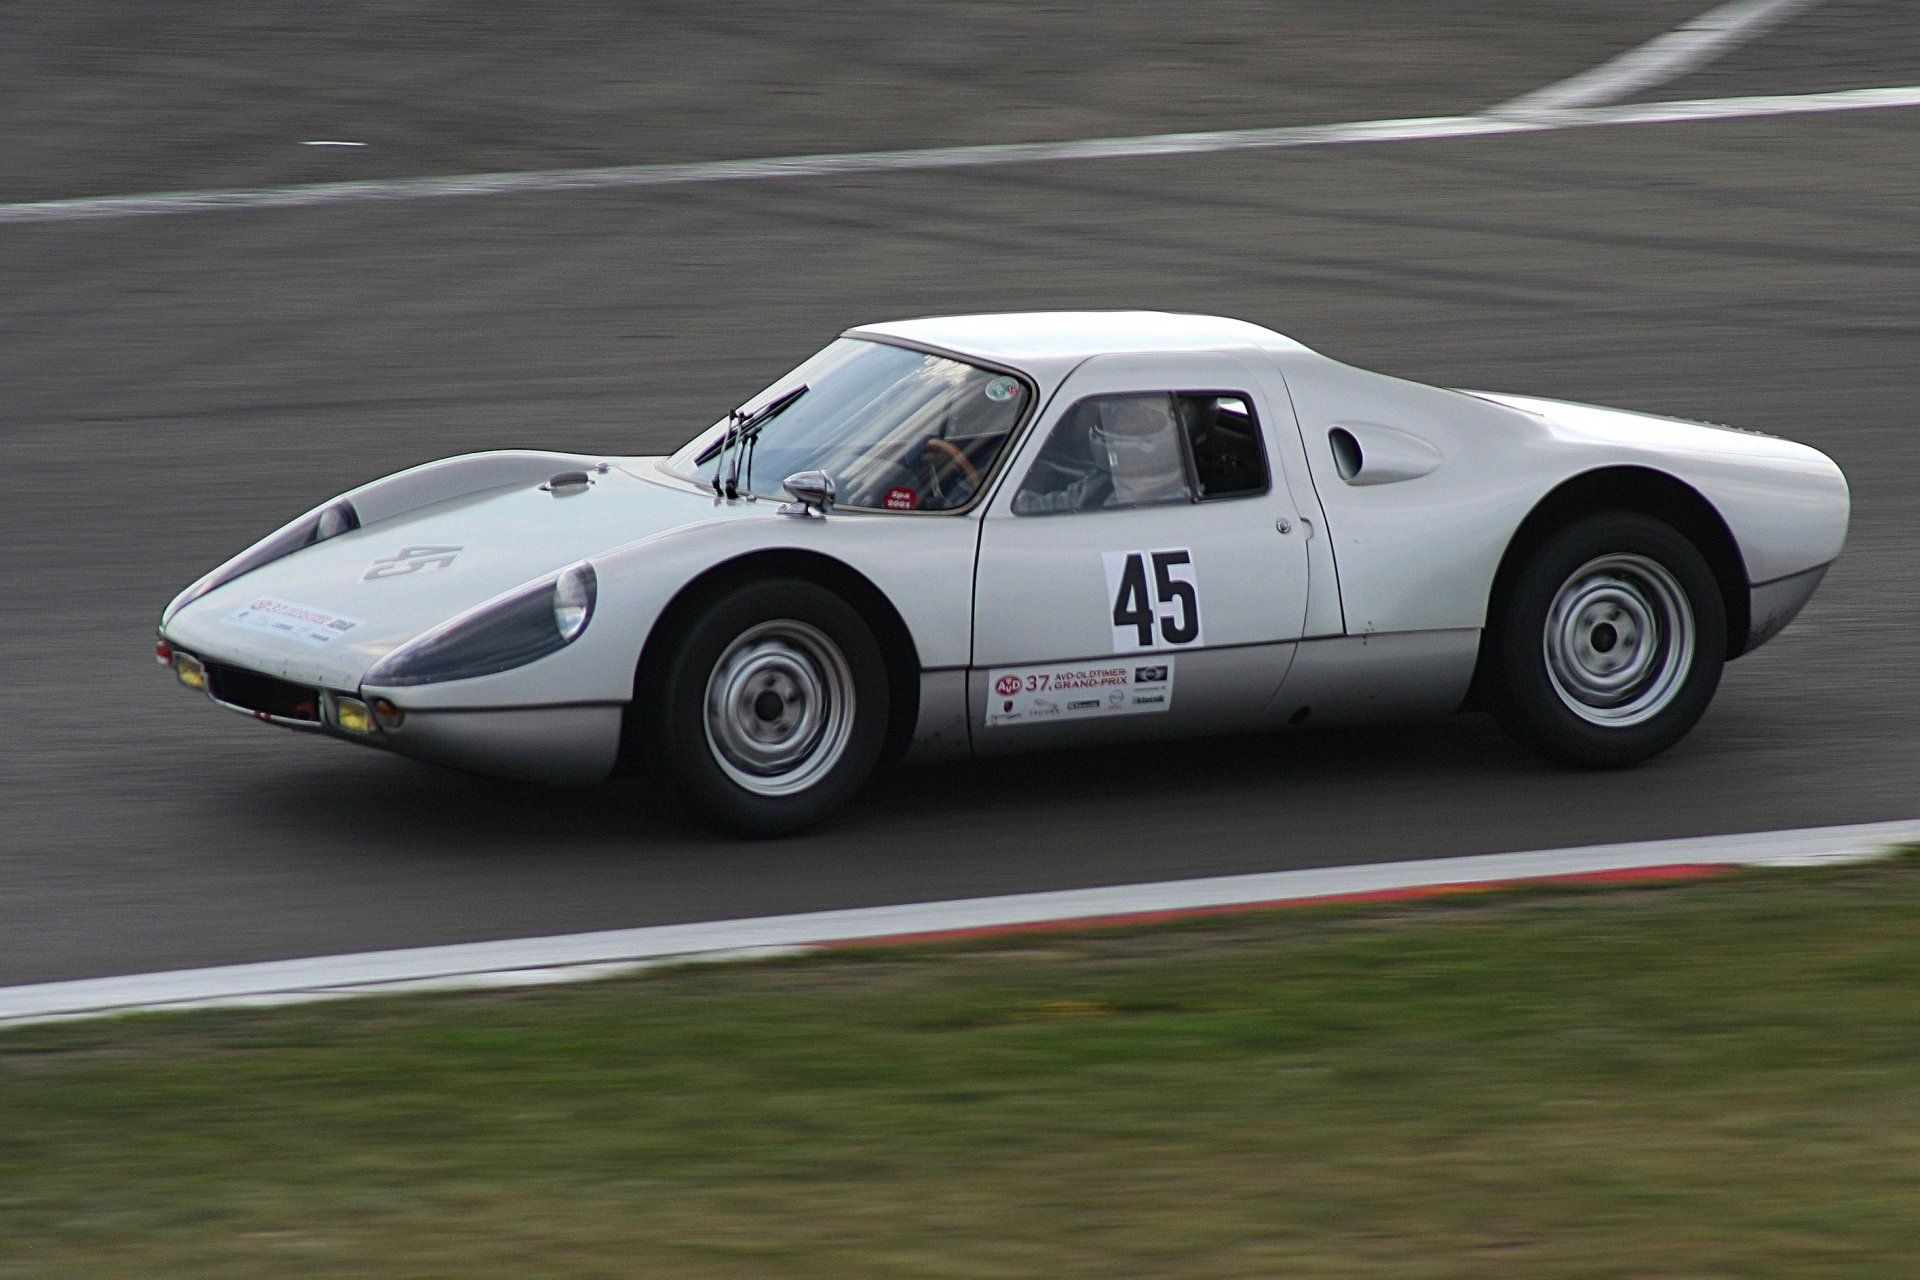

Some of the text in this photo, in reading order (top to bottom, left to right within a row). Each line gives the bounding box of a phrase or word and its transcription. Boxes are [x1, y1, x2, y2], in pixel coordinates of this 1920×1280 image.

[1113, 549, 1199, 646] 45
[1025, 675, 1053, 692] 37.
[1054, 676, 1128, 690] GRAND-PRIX
